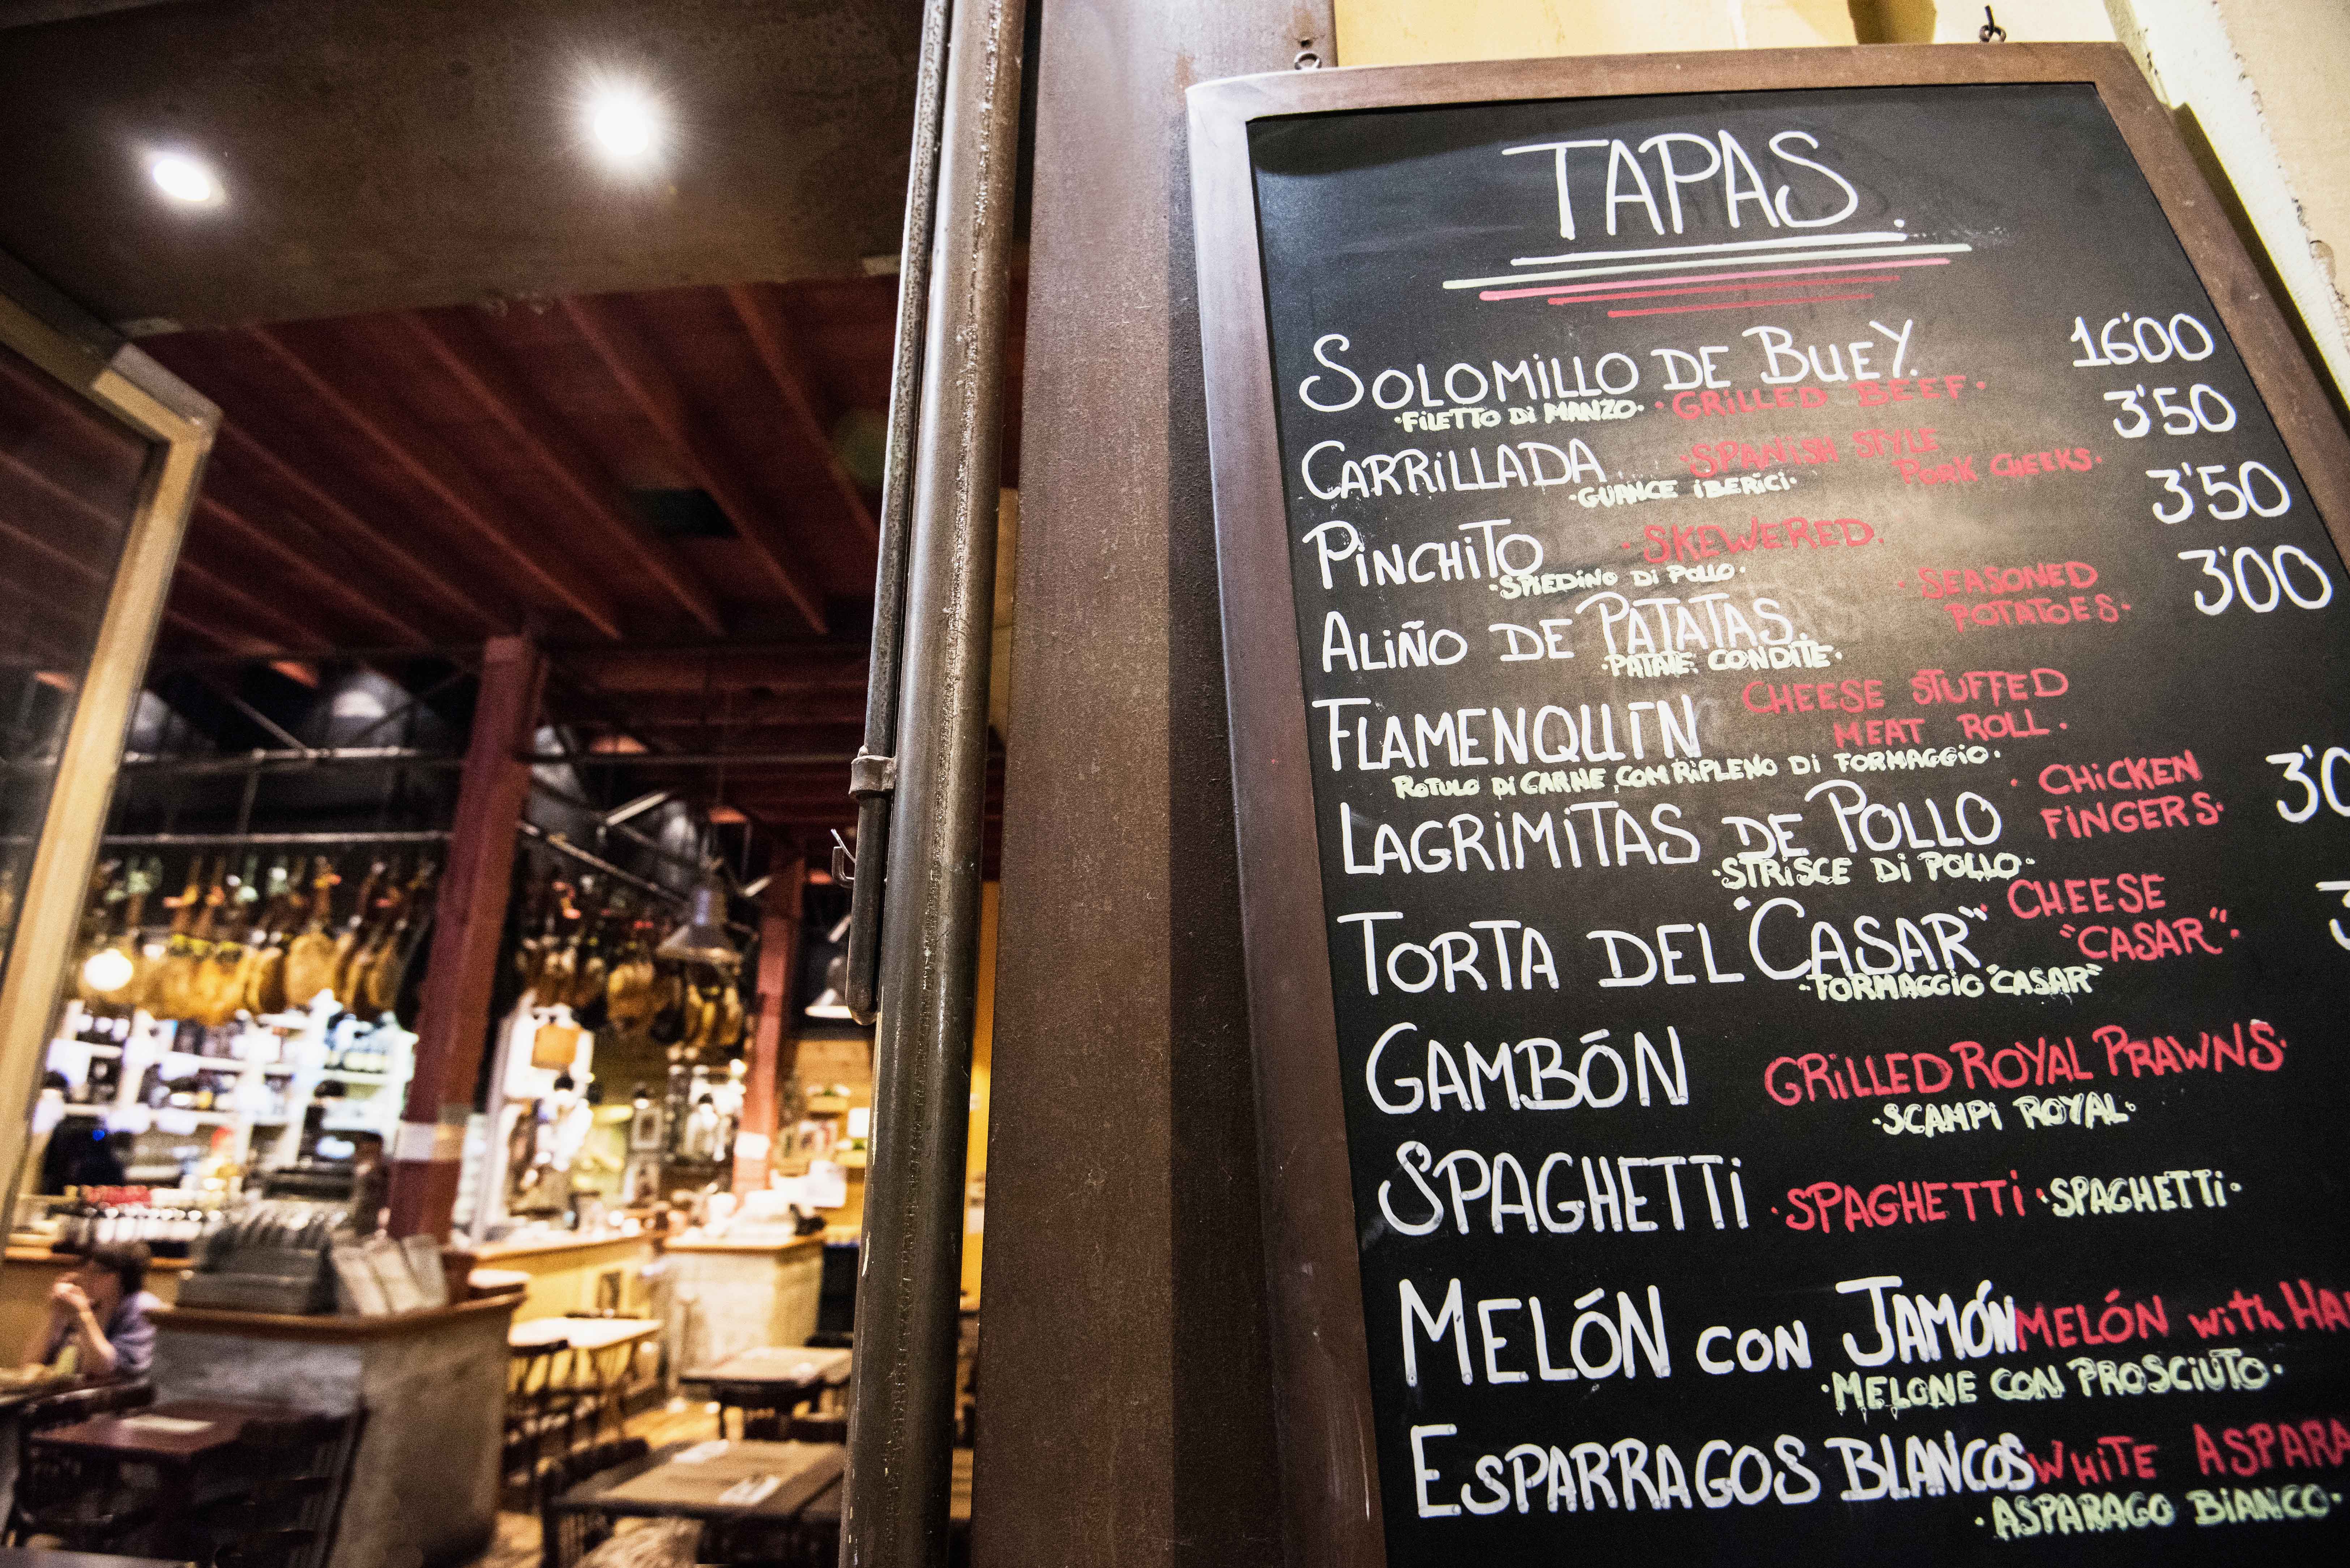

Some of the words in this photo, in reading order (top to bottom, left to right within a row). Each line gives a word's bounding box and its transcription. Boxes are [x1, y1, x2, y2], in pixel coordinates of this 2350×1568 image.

[1650, 346, 1731, 391] DE
[1853, 428, 1940, 460] STYLE
[1892, 455, 1977, 485] PORK
[1917, 561, 2098, 599] SEASONED
[1488, 618, 1574, 661] DE
[1742, 680, 1885, 714] CHEESE
[1910, 668, 2069, 707] STUFFED
[1833, 719, 1925, 748] MEAT
[1519, 767, 1607, 795] CARNE
[1721, 812, 1809, 860] DE
[1804, 779, 2003, 854] POLLO
[2008, 872, 2166, 920] CHEESE
[1337, 911, 1560, 996] TORTA
[1586, 921, 1745, 988] DEL
[1366, 1021, 1689, 1115] GAMBÓN
[1949, 1037, 2094, 1089] ROYAL
[1398, 1277, 1672, 1387] MELÓN
[1835, 1275, 2017, 1368] JAMÓN
[2012, 1289, 2171, 1352] MELÓN
[2278, 1278, 2350, 1334] HA
[1989, 1366, 2067, 1401] CON
[1411, 1423, 1821, 1517] ESPARRAGOS
[1824, 1430, 2035, 1502] BLANCOS
